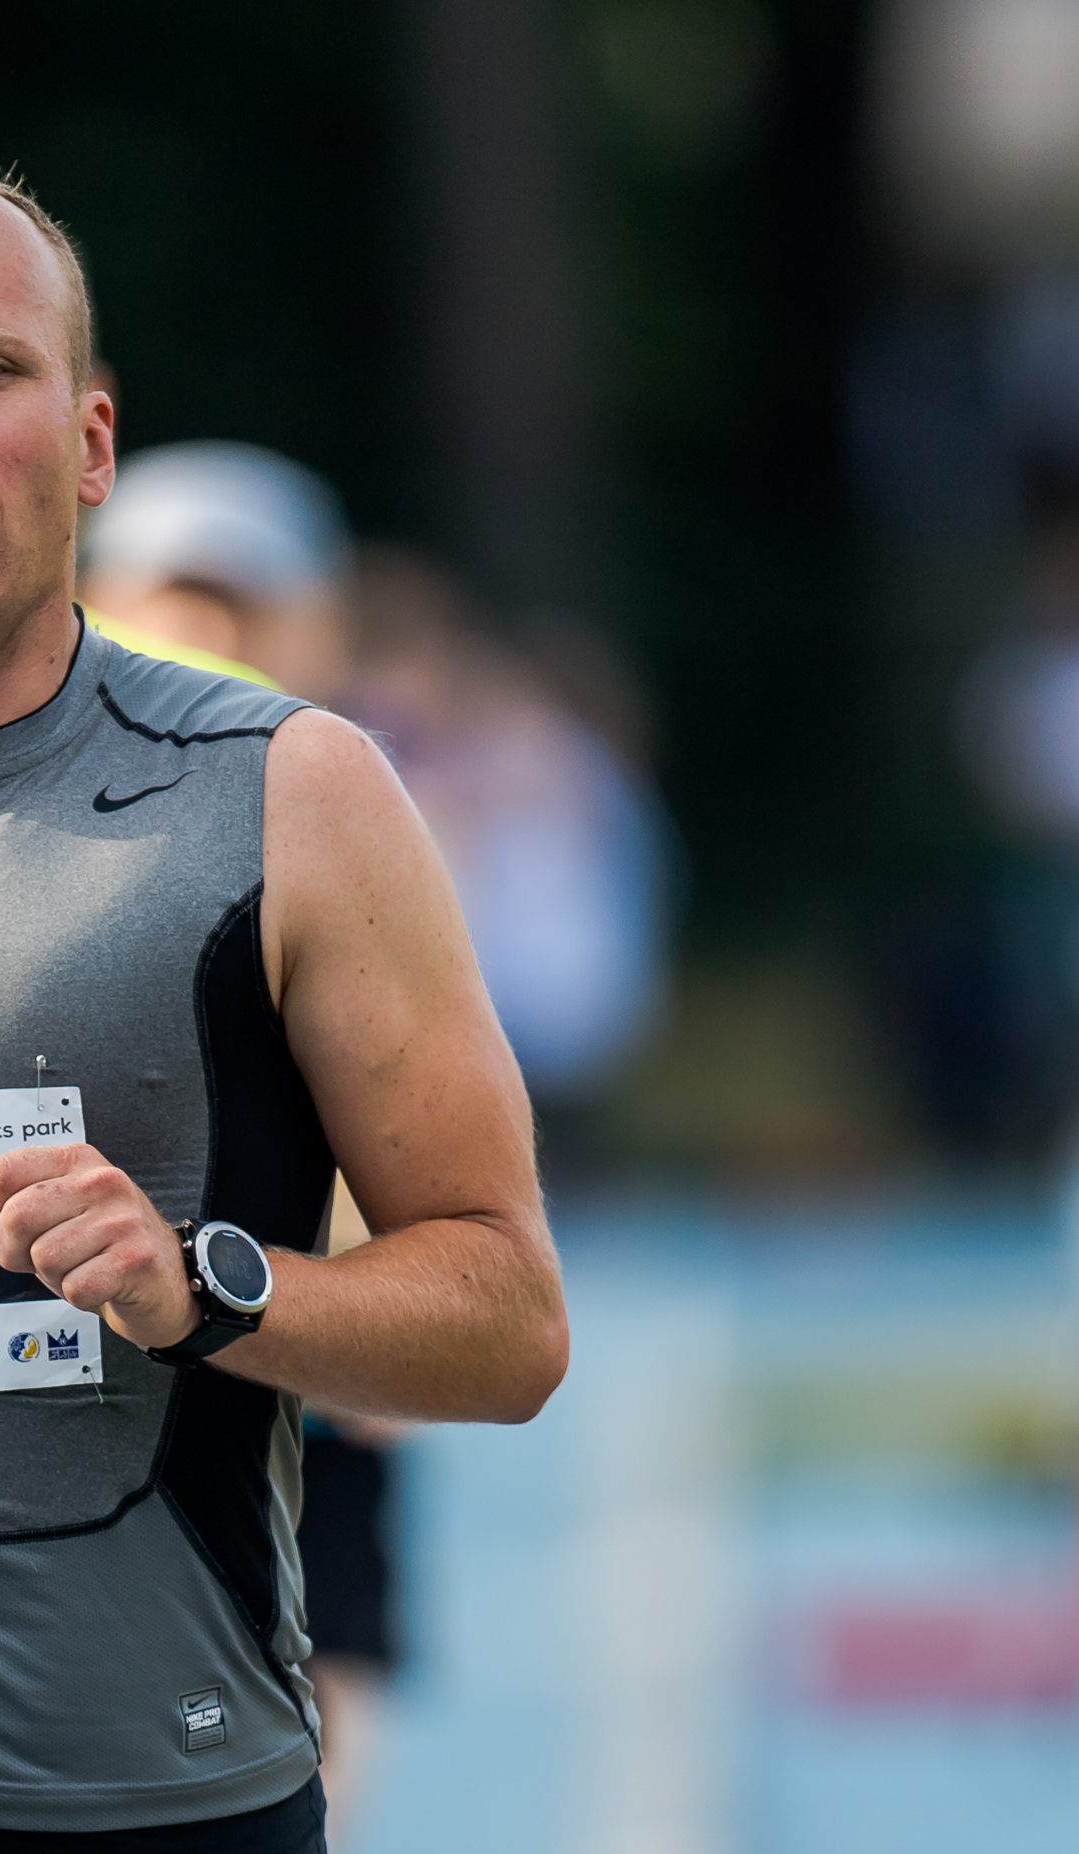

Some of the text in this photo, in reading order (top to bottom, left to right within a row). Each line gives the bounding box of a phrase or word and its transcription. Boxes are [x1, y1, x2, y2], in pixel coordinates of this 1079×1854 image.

[22, 1117, 73, 1142] park
[185, 1707, 221, 1724] NIKE PRO
[188, 1715, 221, 1732] COMBAT
